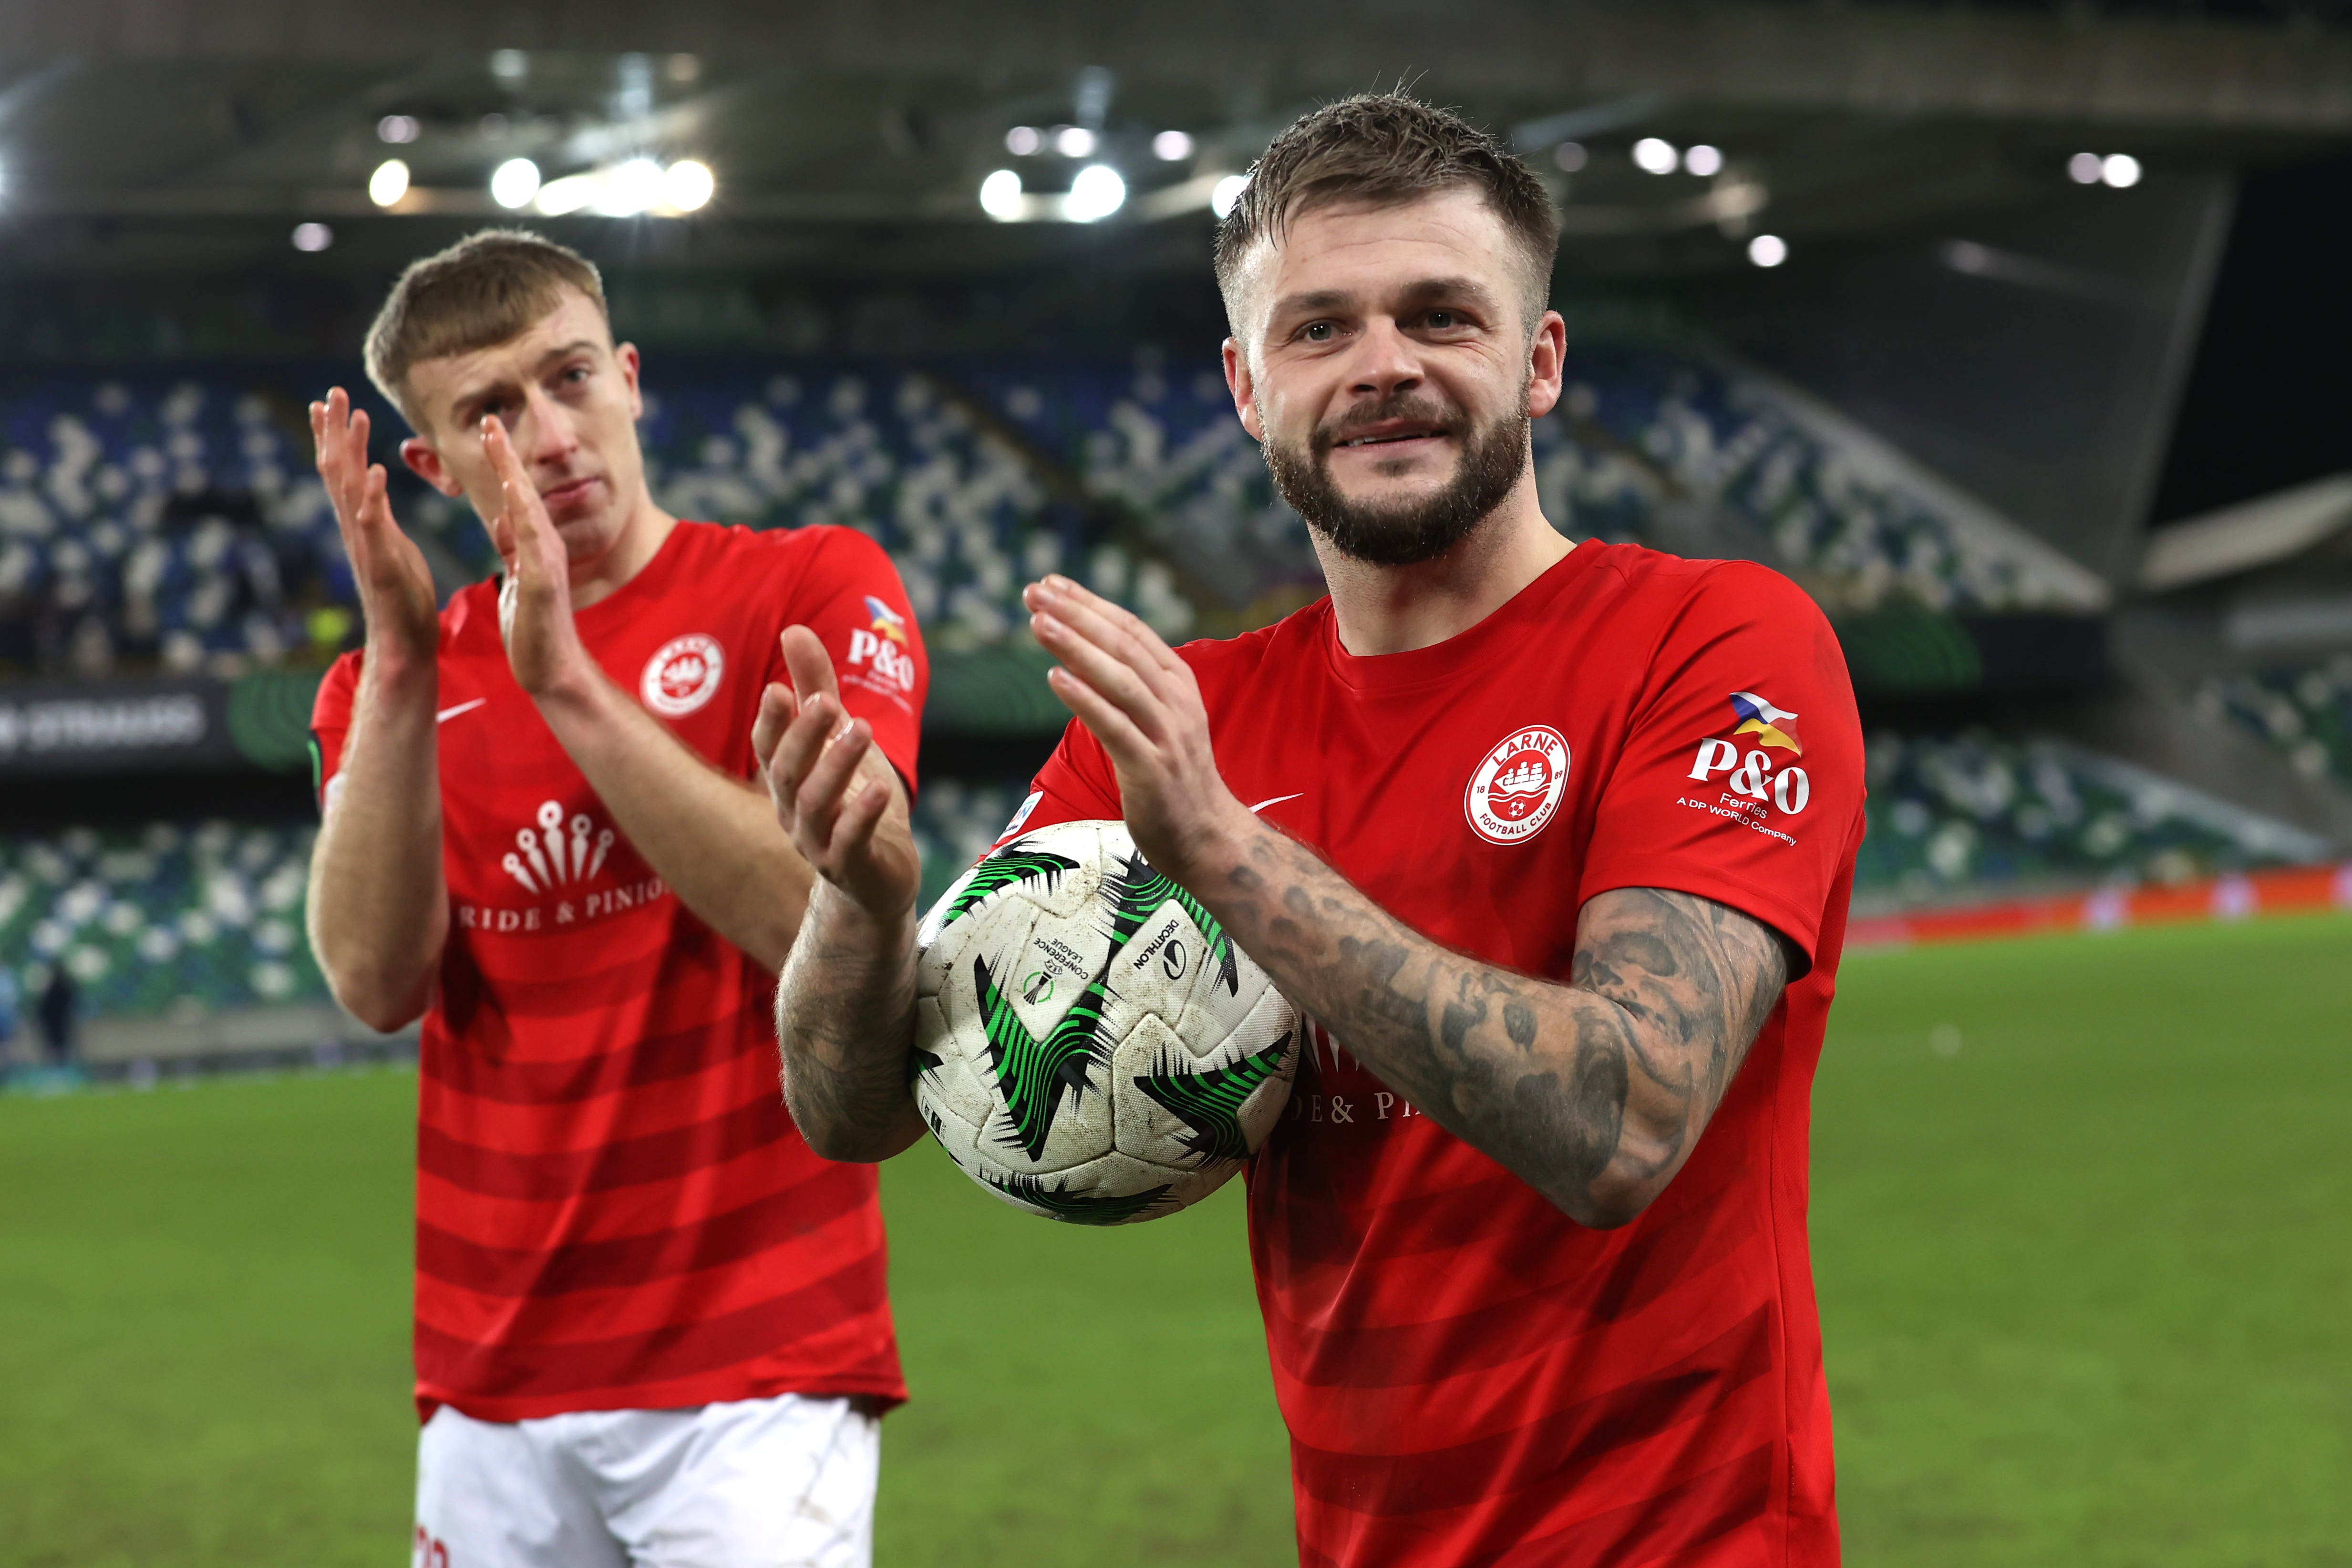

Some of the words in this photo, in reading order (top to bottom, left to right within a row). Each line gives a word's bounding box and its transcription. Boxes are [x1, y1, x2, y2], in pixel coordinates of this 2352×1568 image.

[846, 628, 915, 691] P&O
[1493, 733, 1558, 766] LARNE
[1476, 785, 1485, 794] 18
[1554, 770, 1563, 779] 89
[1687, 737, 1810, 815] P&O
[1479, 813, 1527, 835] FOOTBALL
[1530, 802, 1551, 826] CLUB
[1676, 797, 1686, 805] A
[1689, 800, 1707, 809] DP
[1709, 805, 1749, 825] WORLD
[1751, 821, 1797, 846] Company
[1720, 793, 1767, 819] Ferries
[459, 905, 541, 932] RIDE
[555, 901, 575, 925] &
[586, 876, 670, 918] PINIO
[1033, 938, 1088, 980] CONFERENCE
[1051, 939, 1083, 963] LEAGUE
[1133, 919, 1180, 970] DECATHLON
[1289, 1094, 1322, 1122] DE
[1331, 1095, 1354, 1124] &
[1374, 1092, 1421, 1120] PI
